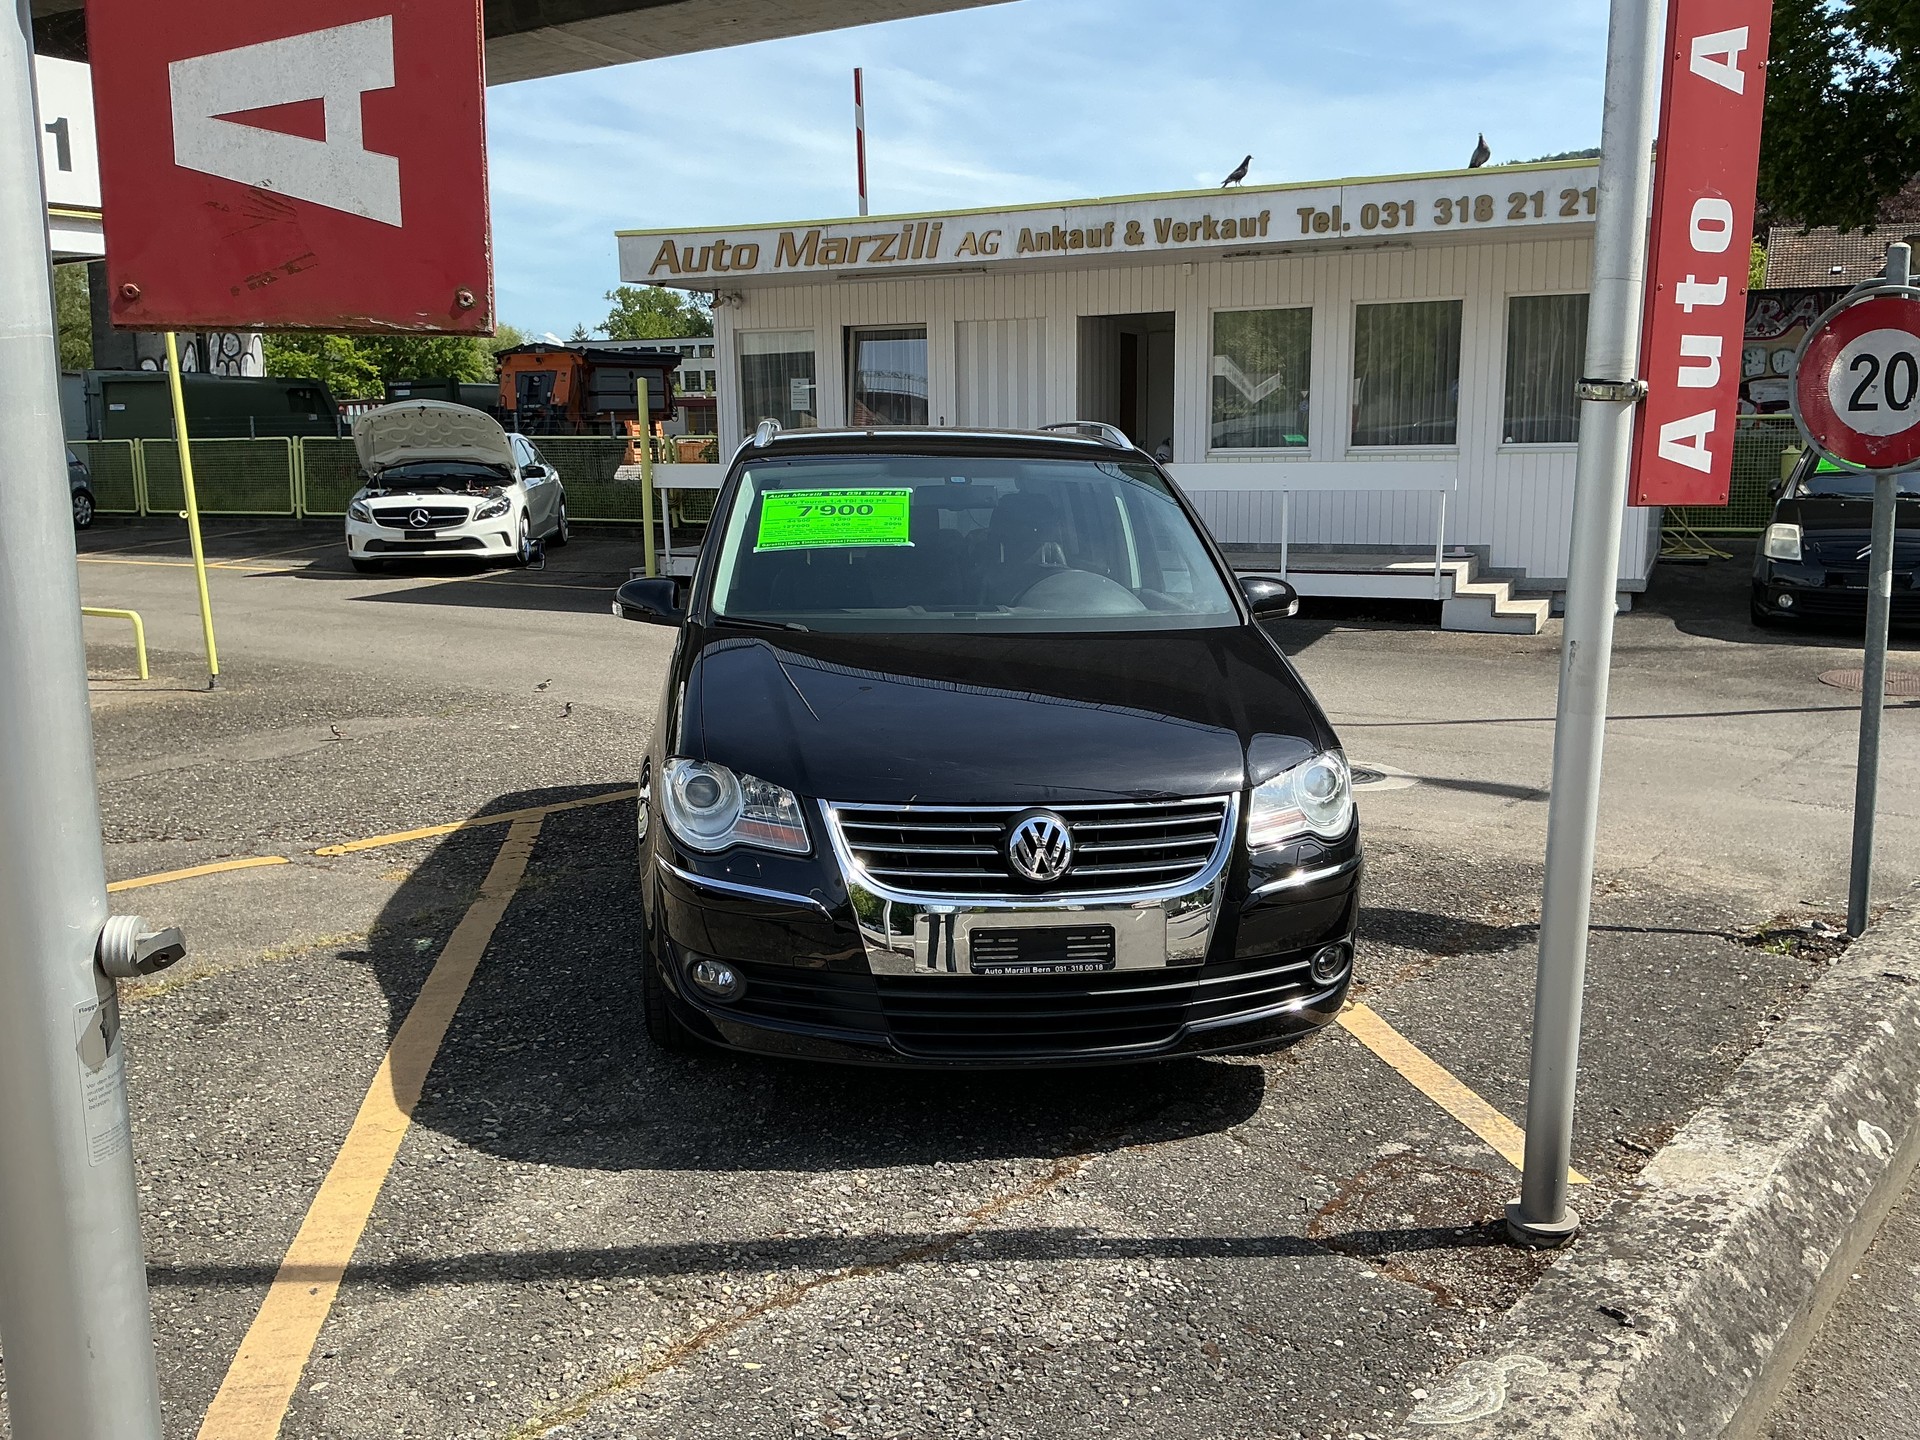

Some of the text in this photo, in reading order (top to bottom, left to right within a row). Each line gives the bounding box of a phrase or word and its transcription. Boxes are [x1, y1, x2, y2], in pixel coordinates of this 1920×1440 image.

[45, 116, 72, 172] 1
[168, 14, 403, 228] A
[648, 186, 1597, 276] Auto Marzili AG Ankauf & Verkauf Tel. 031 318 21 21
[1657, 25, 1749, 475] Auto A
[1847, 351, 1919, 412] 20
[796, 504, 874, 518] 7'900
[1010, 816, 1071, 881] VW
[1004, 966, 1031, 974] Marzili
